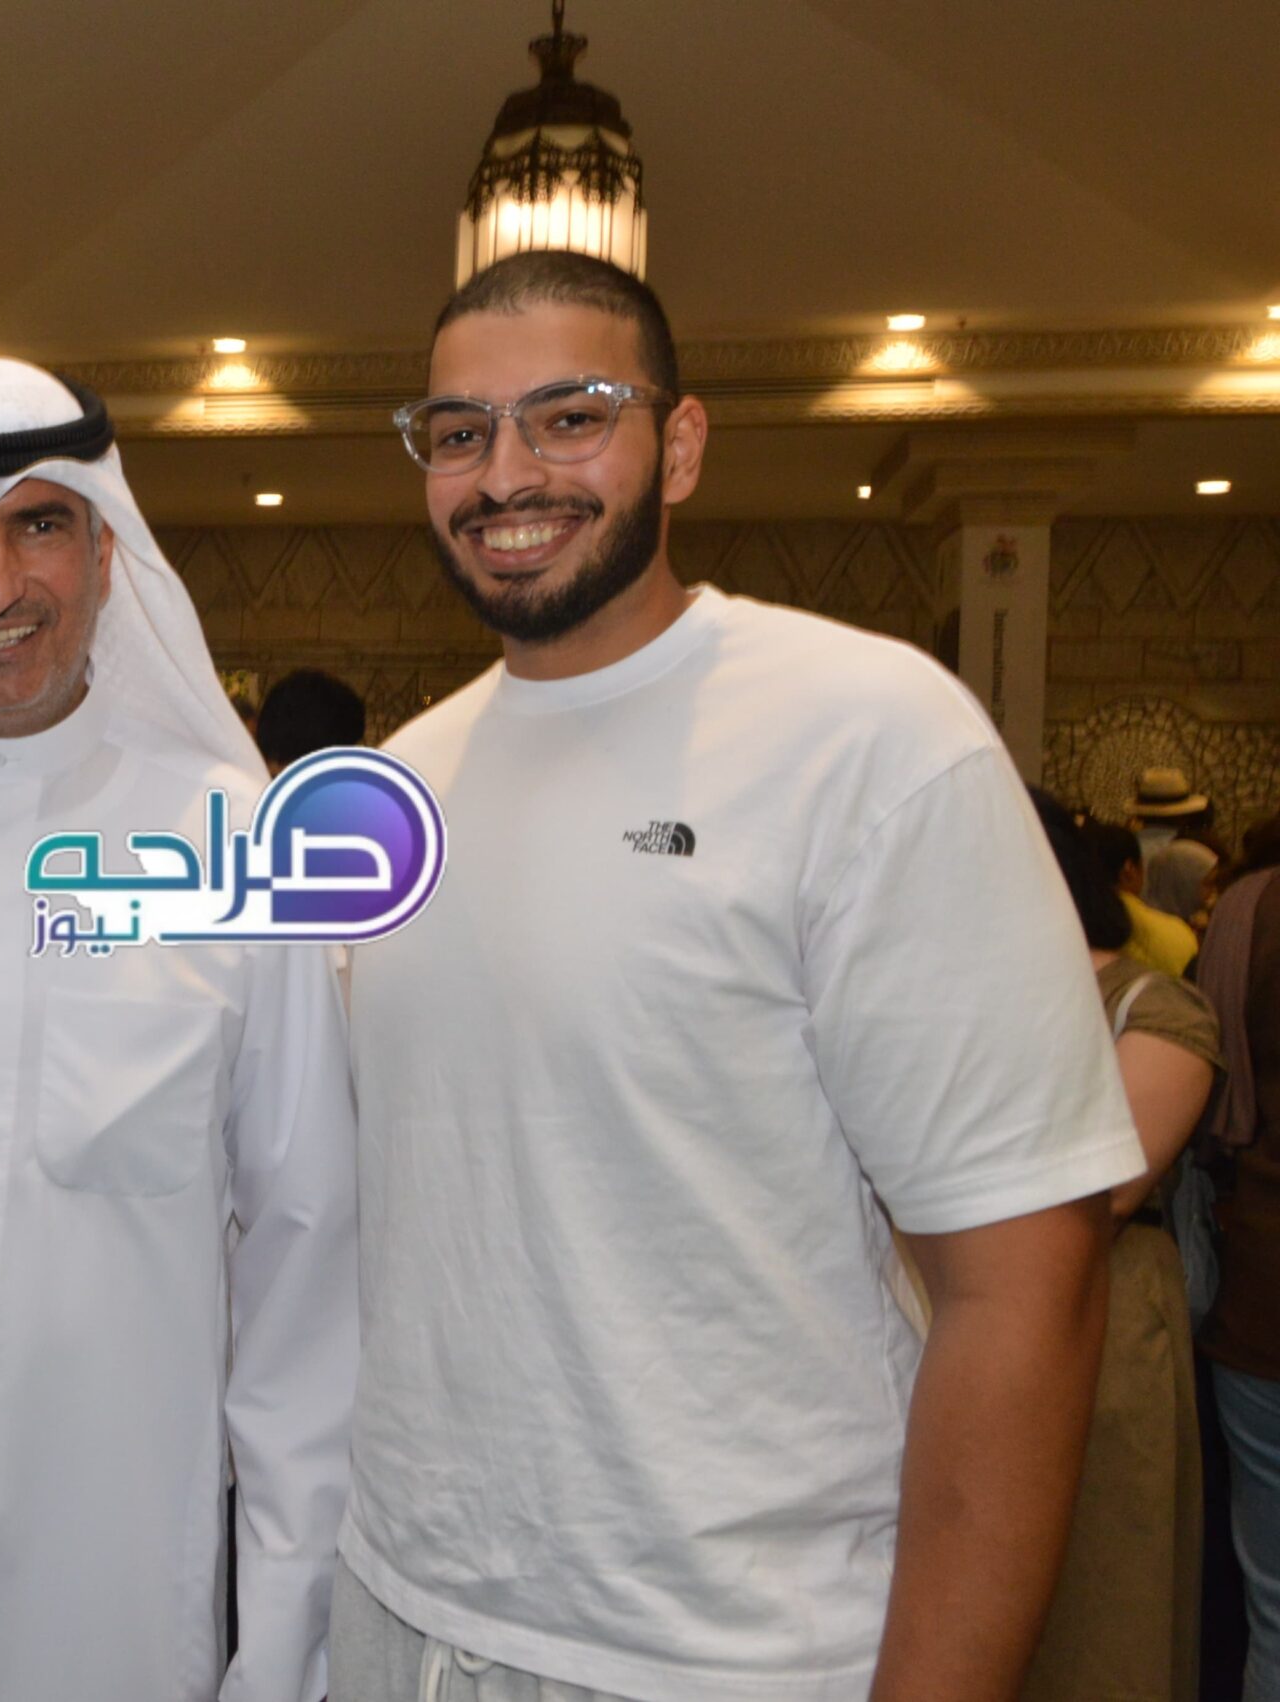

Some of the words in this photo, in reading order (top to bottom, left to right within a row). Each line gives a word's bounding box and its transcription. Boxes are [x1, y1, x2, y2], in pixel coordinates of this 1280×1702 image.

[649, 821, 671, 833] THE
[622, 830, 671, 846] NORTH
[632, 840, 668, 855] FACE
